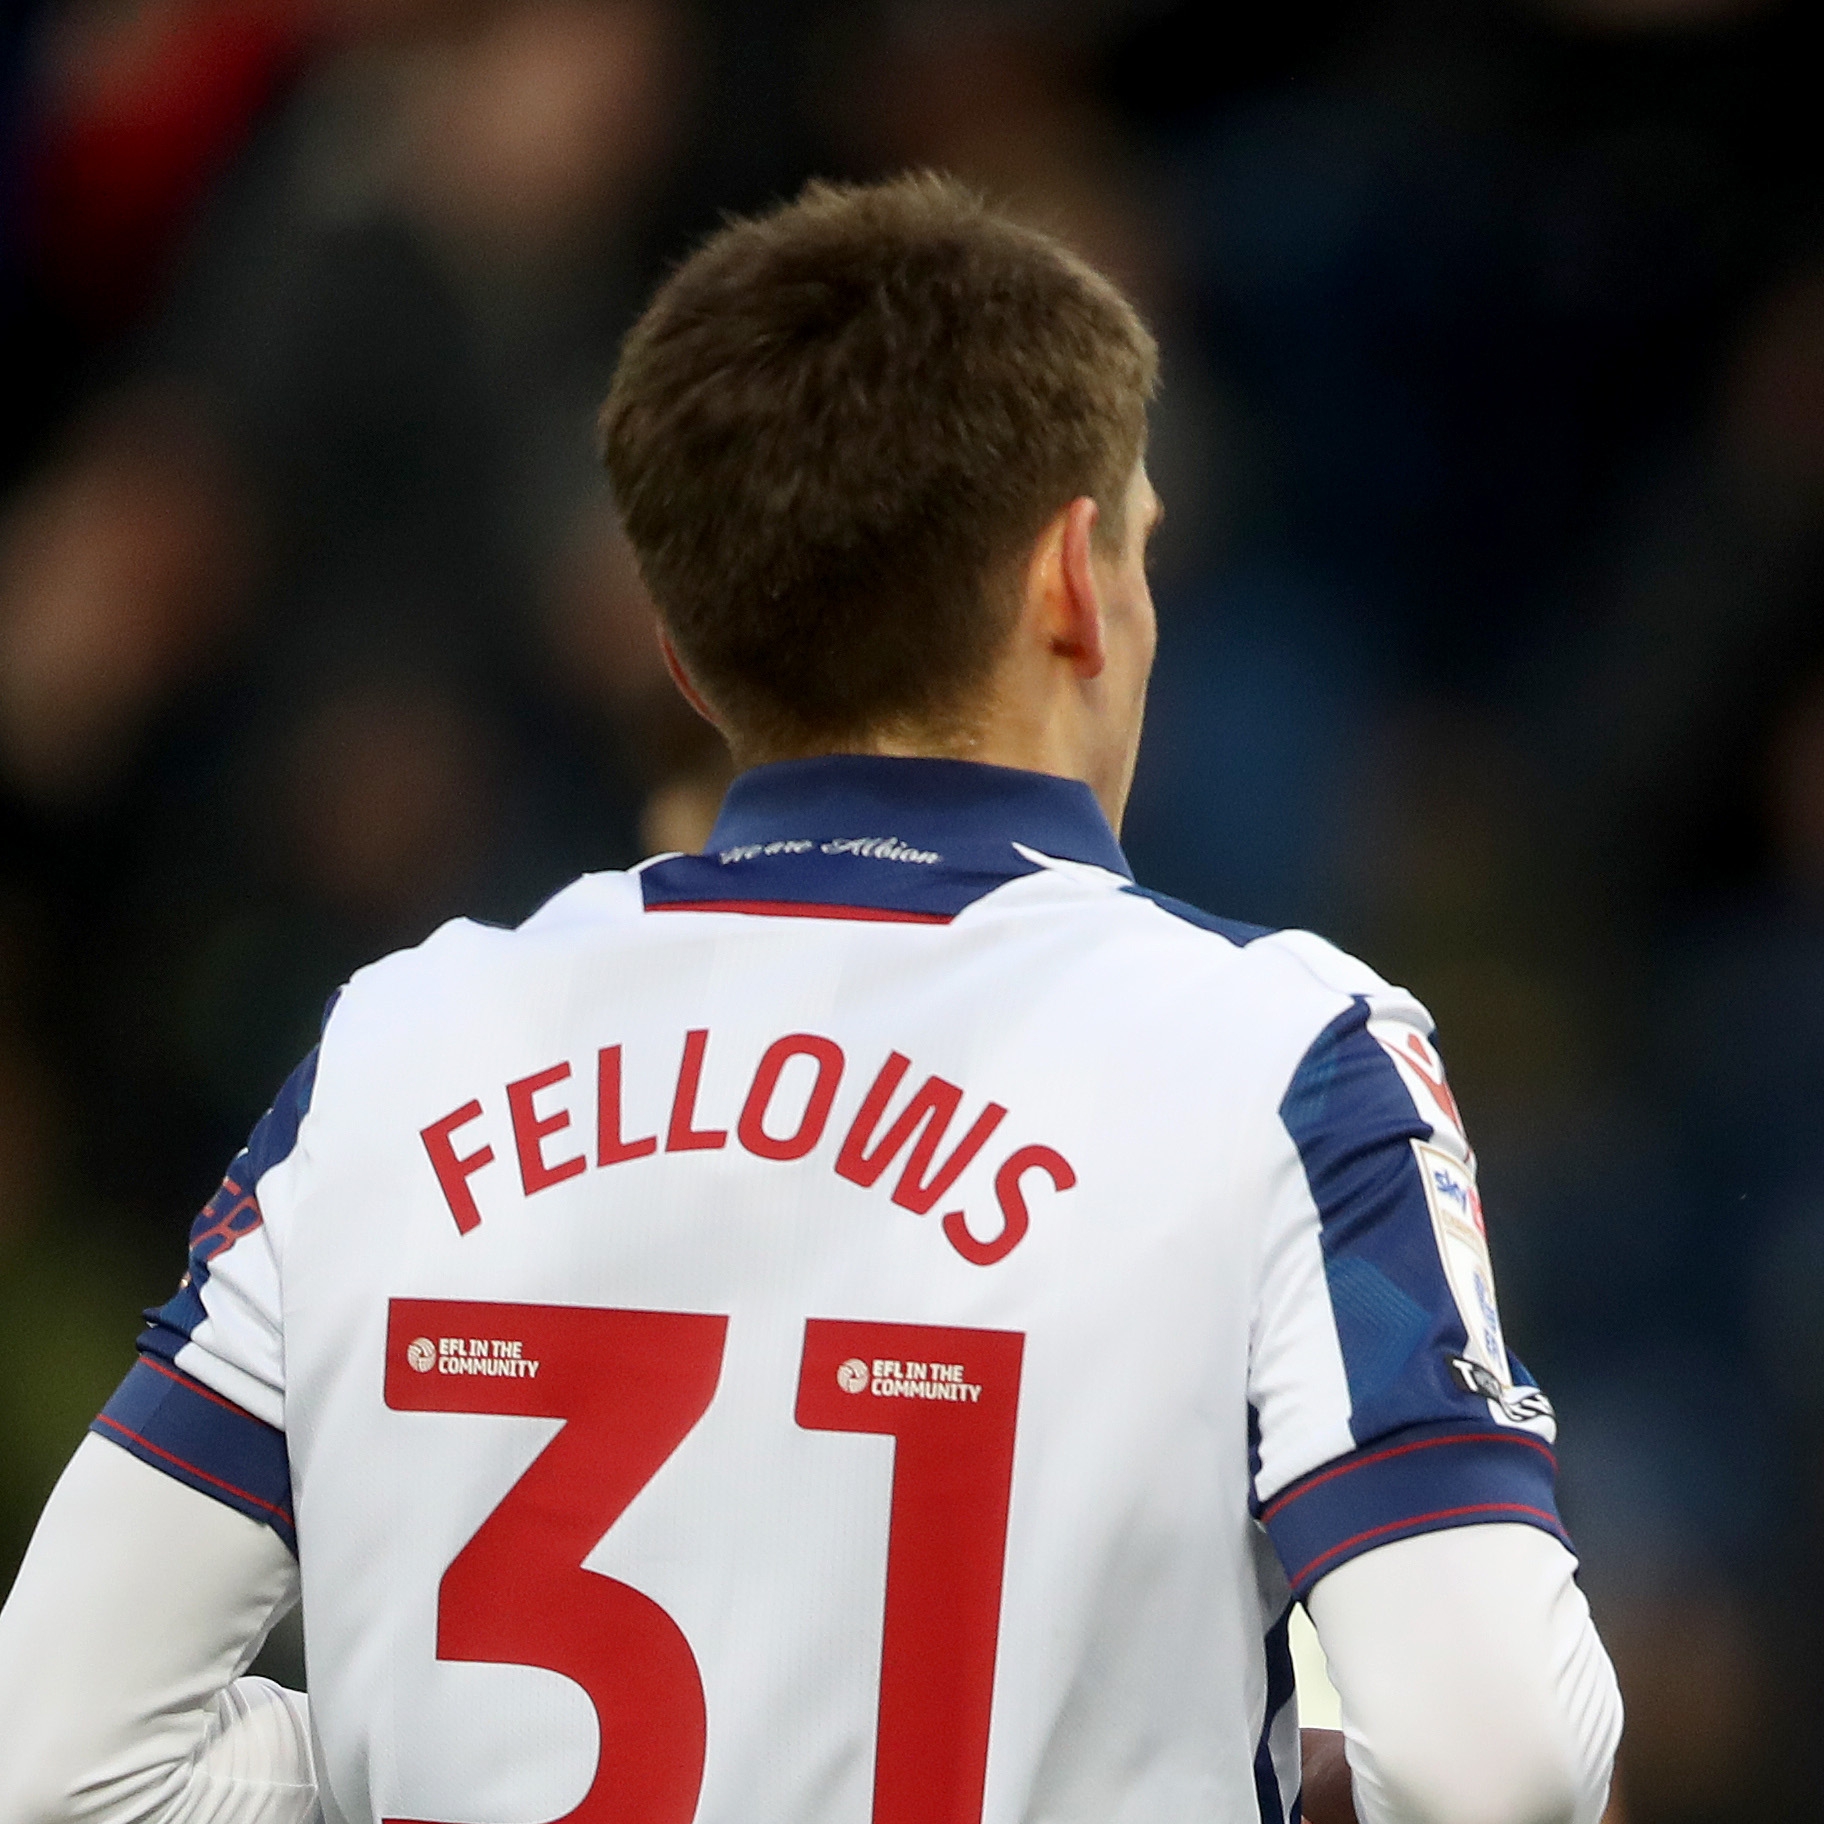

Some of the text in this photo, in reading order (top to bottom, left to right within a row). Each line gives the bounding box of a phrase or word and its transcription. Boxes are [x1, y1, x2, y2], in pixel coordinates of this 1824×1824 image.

[820, 836, 942, 864] Albion
[418, 1028, 1077, 1267] FELLOWS
[438, 1337, 523, 1359] EFL IN THE
[438, 1356, 540, 1378] COMMUNITY
[871, 1359, 965, 1383] EFL IN THE
[870, 1378, 983, 1403] COMMUNITY
